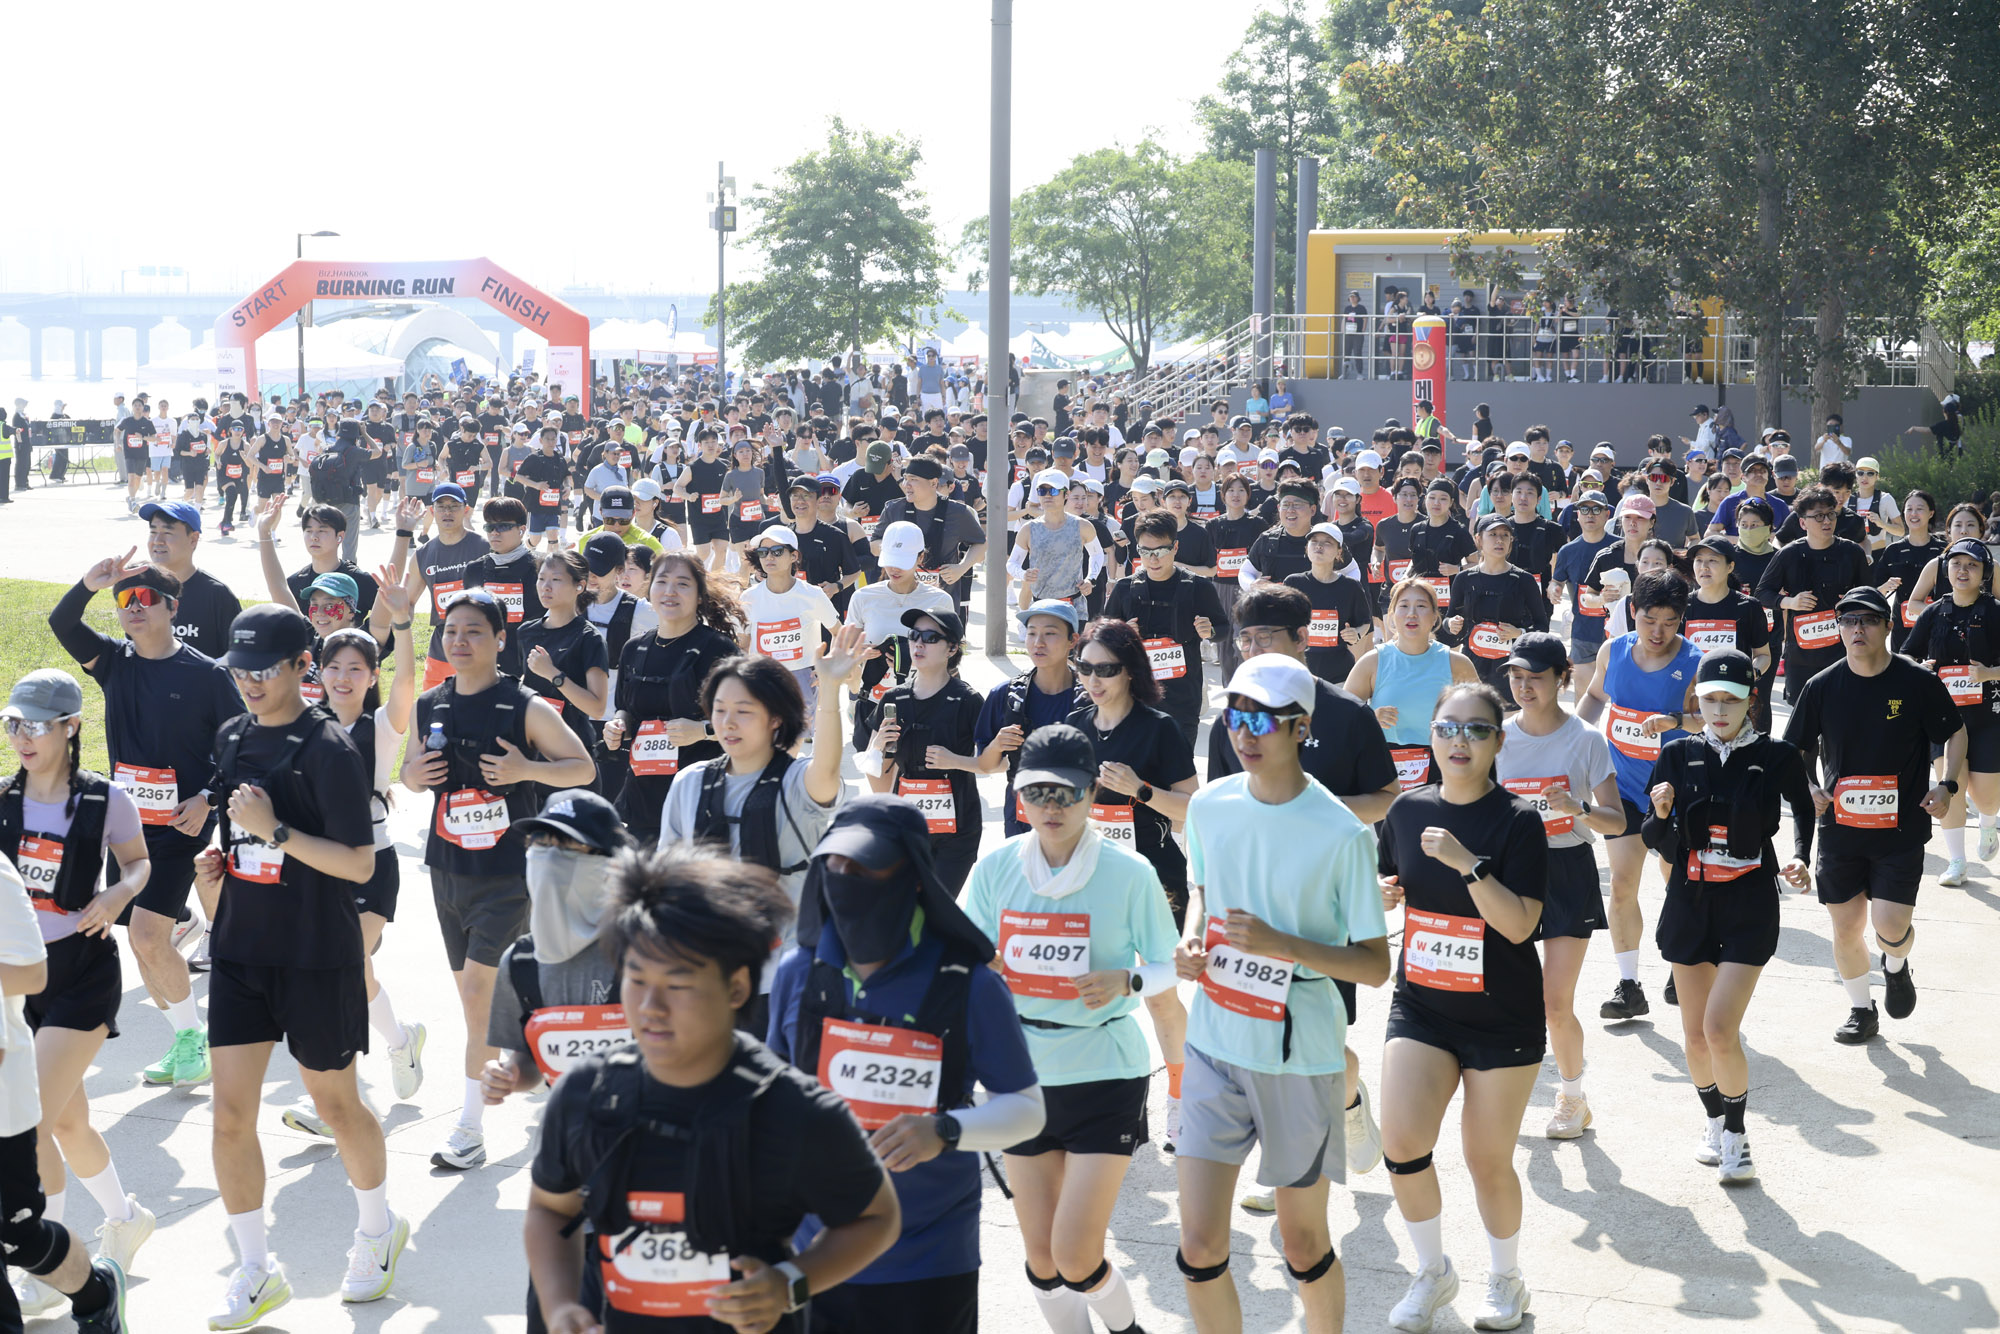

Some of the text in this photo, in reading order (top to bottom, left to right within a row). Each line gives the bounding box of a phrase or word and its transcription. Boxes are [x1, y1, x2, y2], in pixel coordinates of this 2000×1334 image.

[316, 277, 455, 296] BURNING RUN
[232, 279, 287, 328] START
[482, 277, 551, 327] FINISH
[53, 421, 77, 429] SAMIK
[426, 561, 467, 576] Champi
[1434, 587, 1448, 595] 731
[503, 597, 522, 606] 208
[1311, 622, 1337, 632] 3992
[1811, 623, 1836, 634] 1544
[773, 632, 801, 645] 3736
[1704, 634, 1734, 643] 4475
[1153, 650, 1182, 662] 2048
[1952, 680, 1980, 688] 4022
[1614, 725, 1622, 733] M
[634, 743, 641, 751] W
[137, 786, 176, 801] 2367
[915, 799, 952, 811] 4374
[1845, 794, 1896, 806] M 1730
[449, 806, 504, 824] M 1944
[1099, 827, 1132, 840] 286
[1031, 917, 1049, 926] RUN
[1064, 920, 1086, 929] 10km
[1408, 912, 1480, 933] BURNING RUN 10km
[1012, 944, 1087, 962] W 4097
[1416, 940, 1480, 961] W 4145
[1213, 955, 1228, 969] M
[1234, 958, 1288, 986] 1982
[870, 1031, 894, 1043] RUN
[548, 1044, 560, 1056] M
[840, 1063, 934, 1089] M 2324
